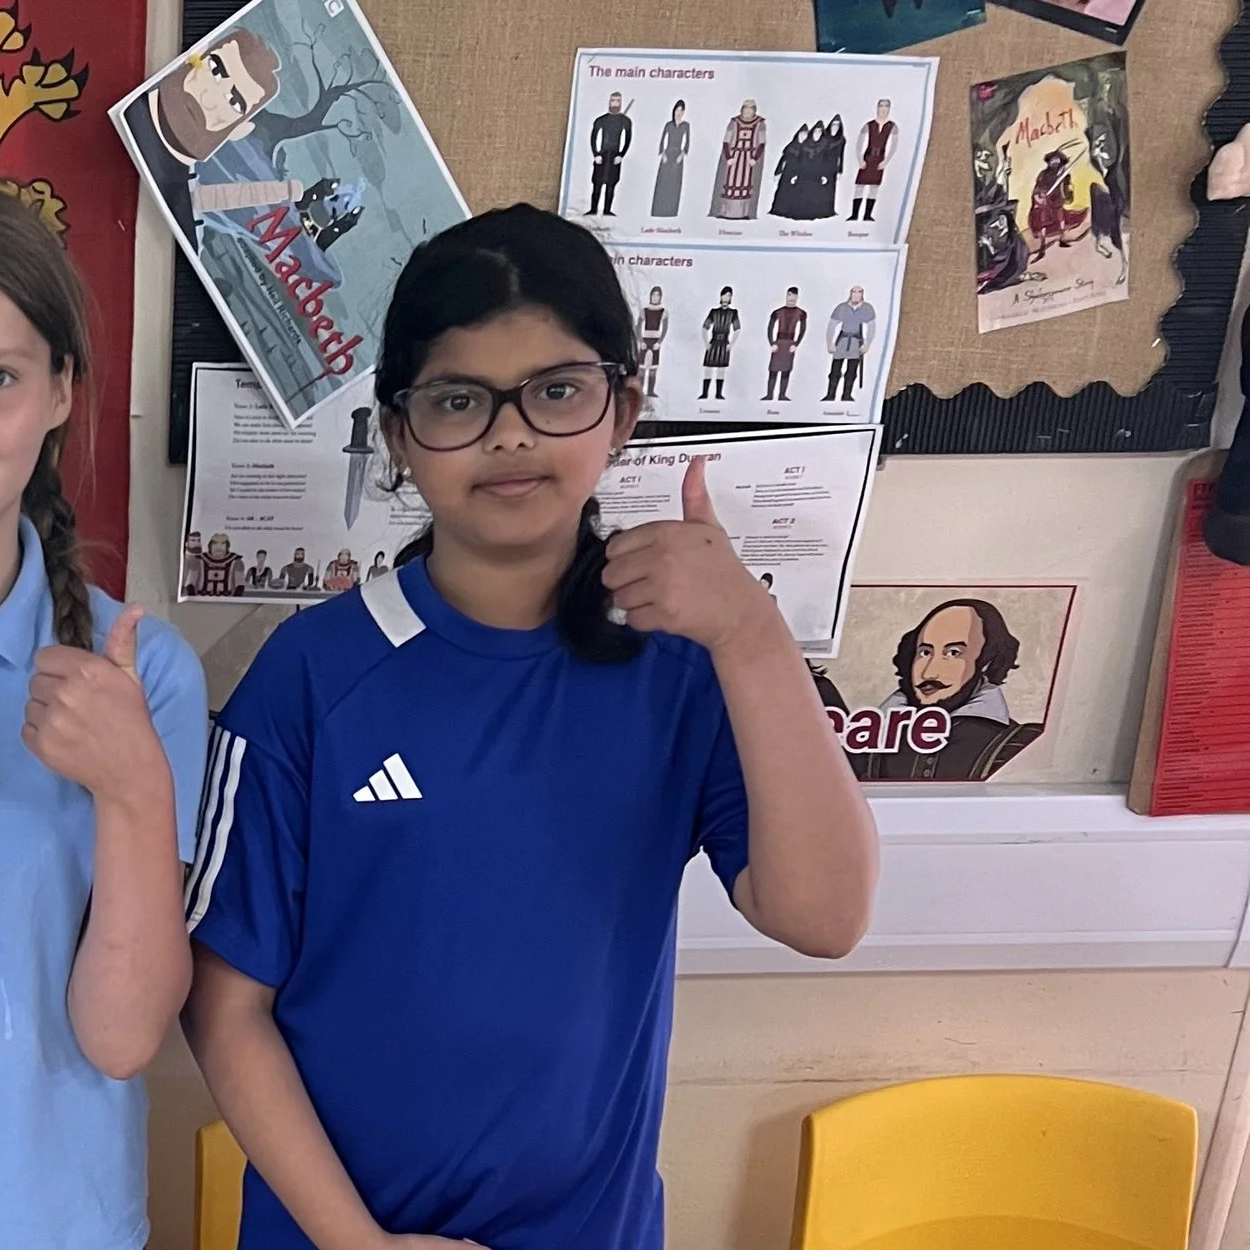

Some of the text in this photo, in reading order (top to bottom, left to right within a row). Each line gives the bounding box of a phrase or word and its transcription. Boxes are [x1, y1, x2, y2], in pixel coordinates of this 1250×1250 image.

[588, 65, 715, 80] The main characters
[1014, 108, 1079, 149] Macbeth
[628, 254, 694, 267] characters
[244, 205, 365, 377] Macbeth
[633, 454, 647, 467] of
[649, 453, 676, 468] King
[784, 466, 801, 475] ACT
[619, 476, 637, 484] ACT
[772, 518, 788, 526] ACT
